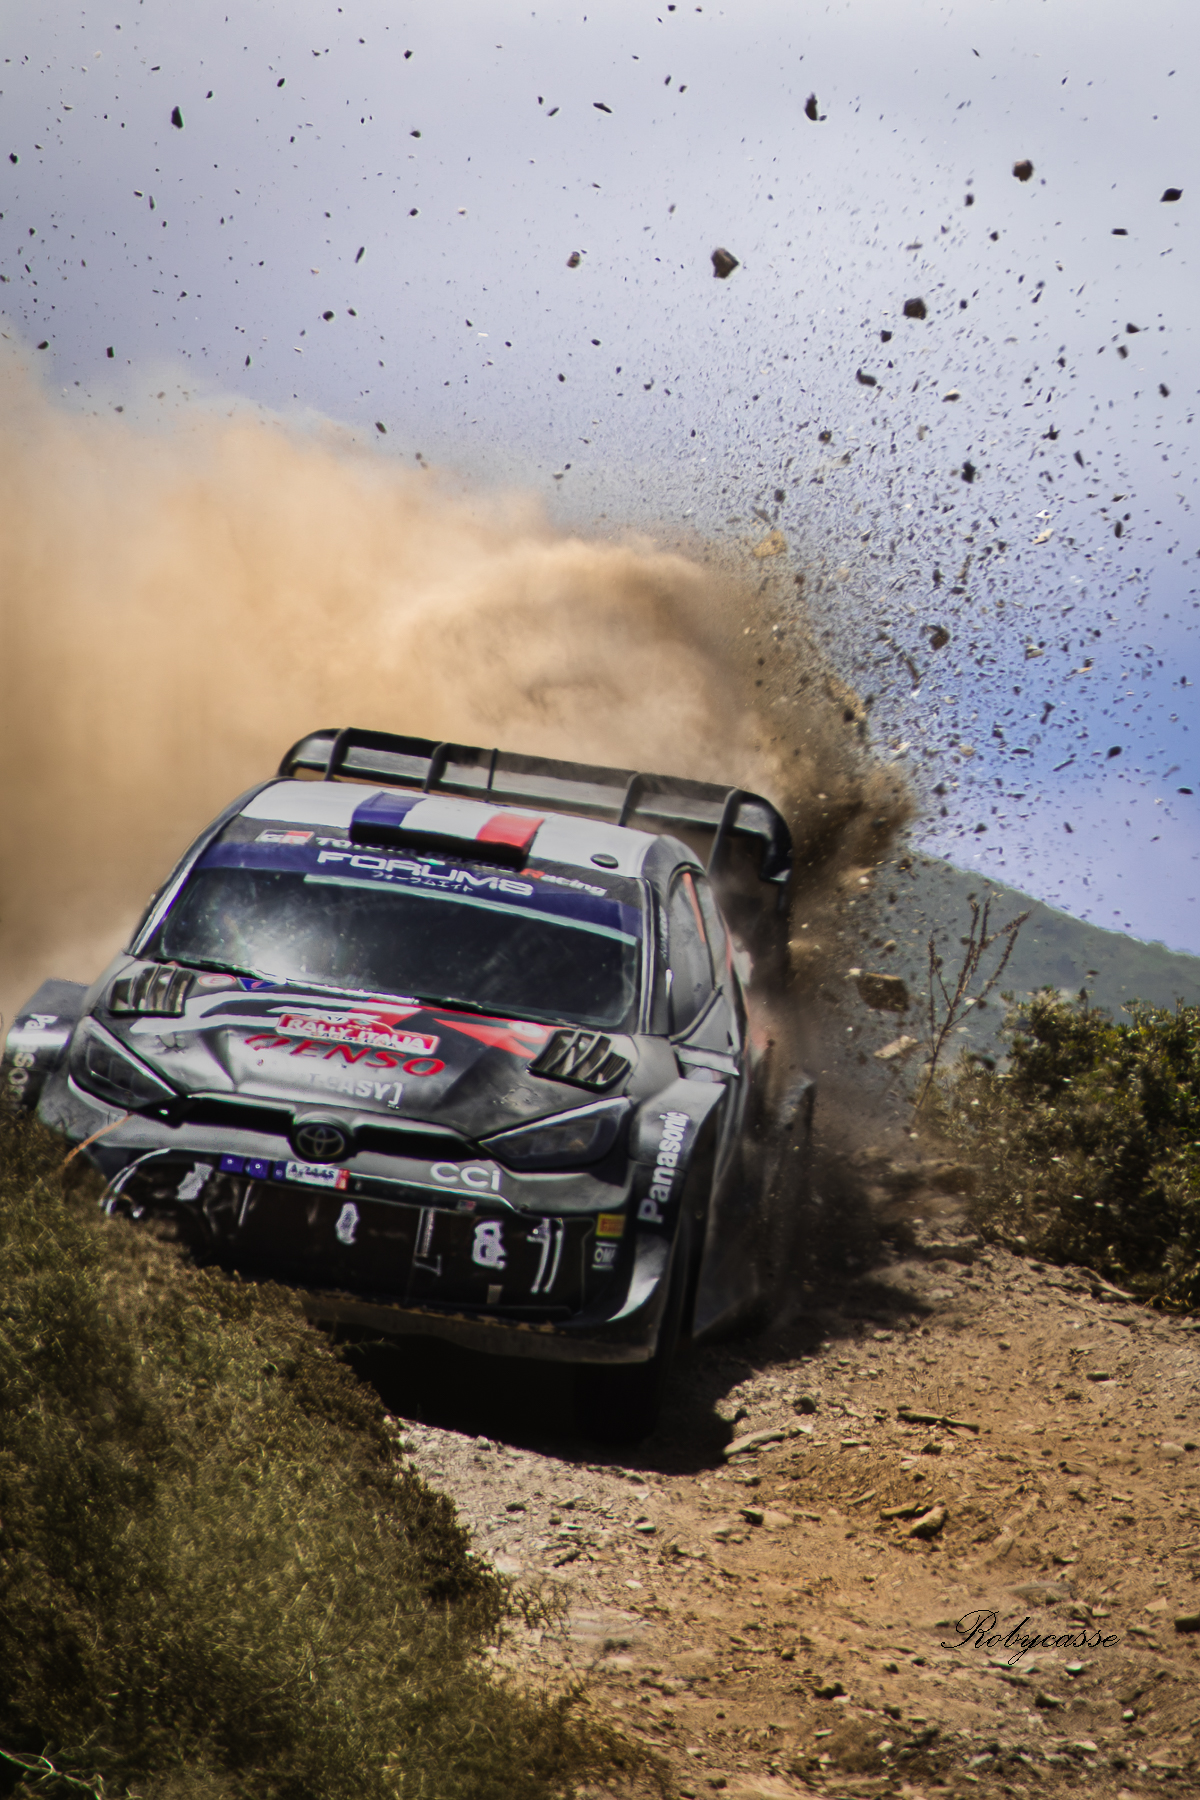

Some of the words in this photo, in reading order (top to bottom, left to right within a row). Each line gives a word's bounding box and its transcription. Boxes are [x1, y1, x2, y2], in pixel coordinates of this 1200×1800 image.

[317, 850, 534, 896] FORUM8
[520, 868, 607, 896] Racing
[287, 1018, 353, 1041] RALLY
[358, 1030, 426, 1049] ITALIA
[637, 1111, 690, 1224] Panasonic
